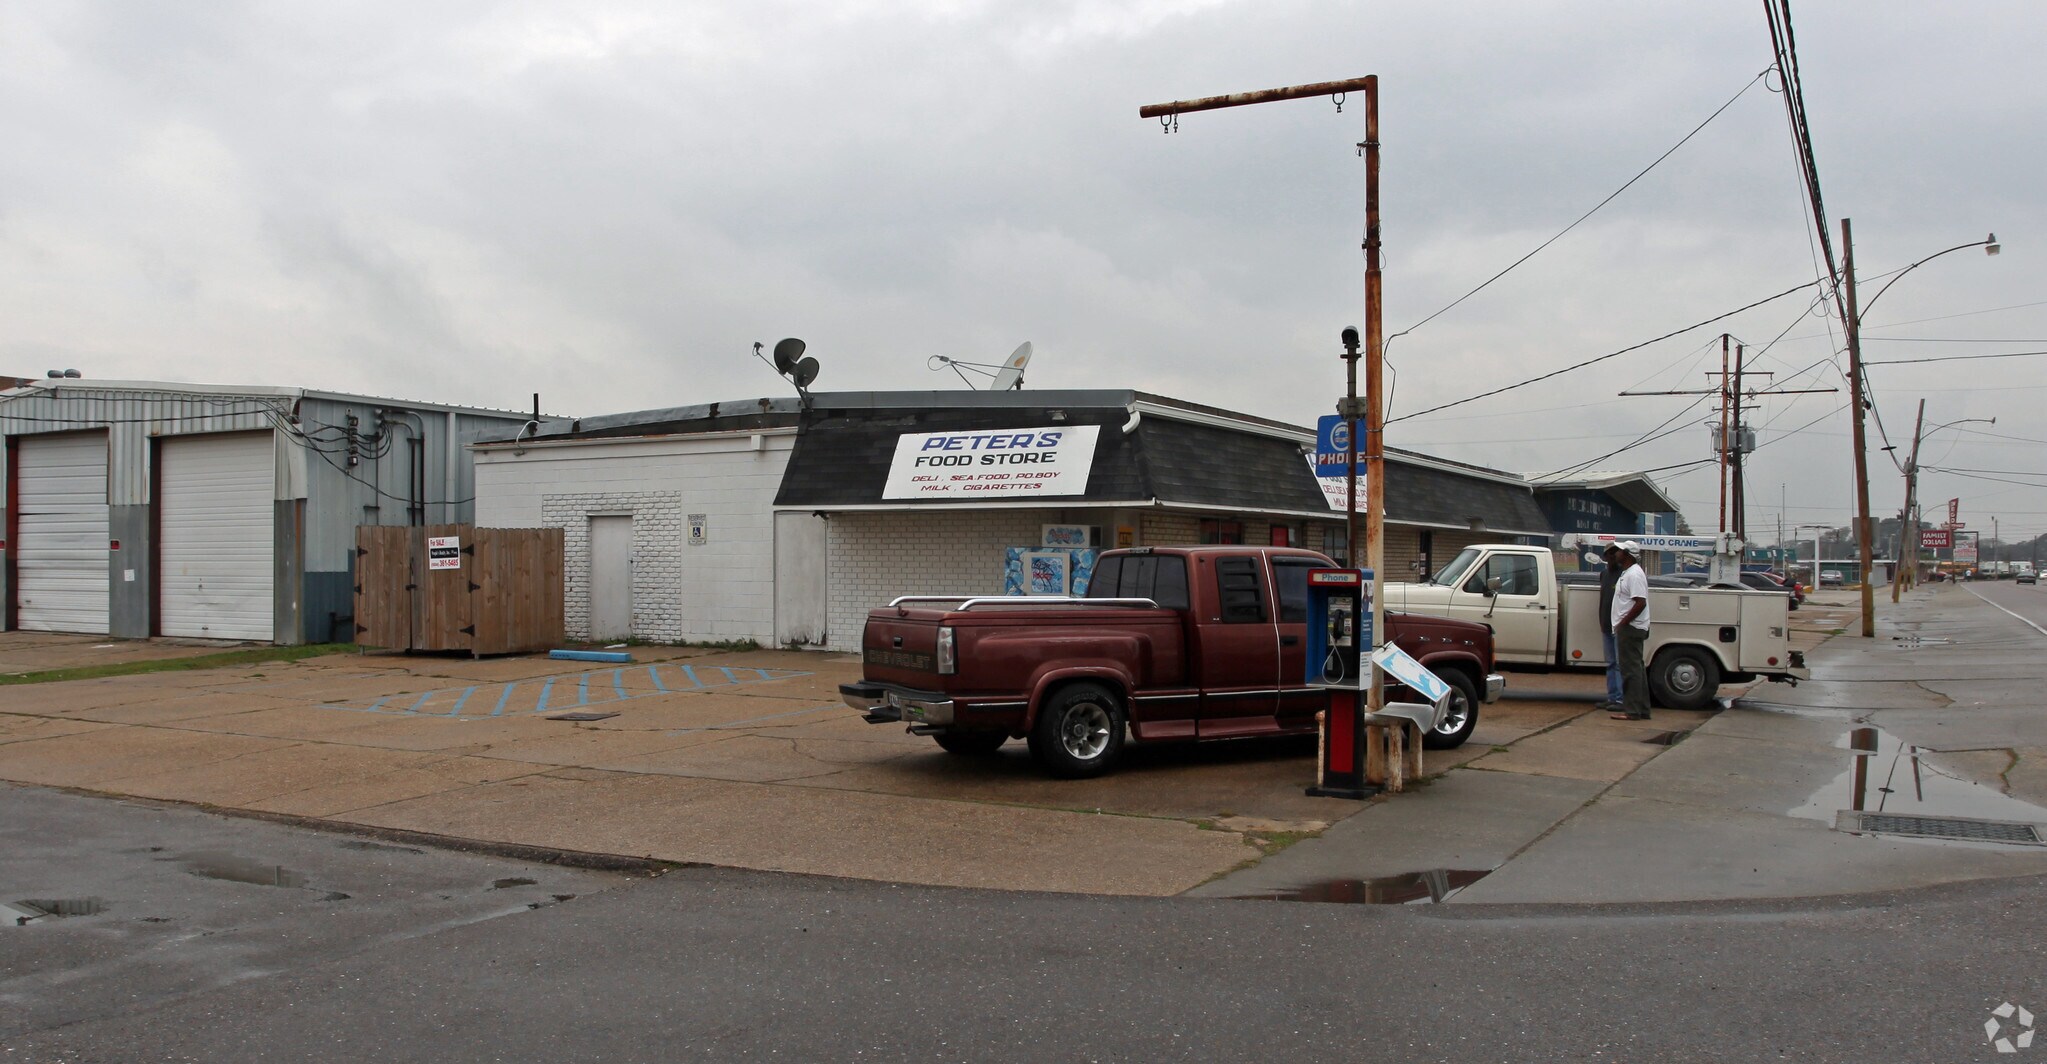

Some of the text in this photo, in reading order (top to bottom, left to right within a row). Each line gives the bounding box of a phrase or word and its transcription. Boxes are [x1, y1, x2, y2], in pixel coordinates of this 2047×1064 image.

[921, 432, 1063, 451] PETER'S
[915, 451, 1058, 468] FOOD STORE
[962, 483, 1043, 491] CIGARETTES
[1668, 539, 1699, 547] CRANE
[1321, 574, 1349, 582] Phone
[869, 649, 931, 669] CHEVROLET
